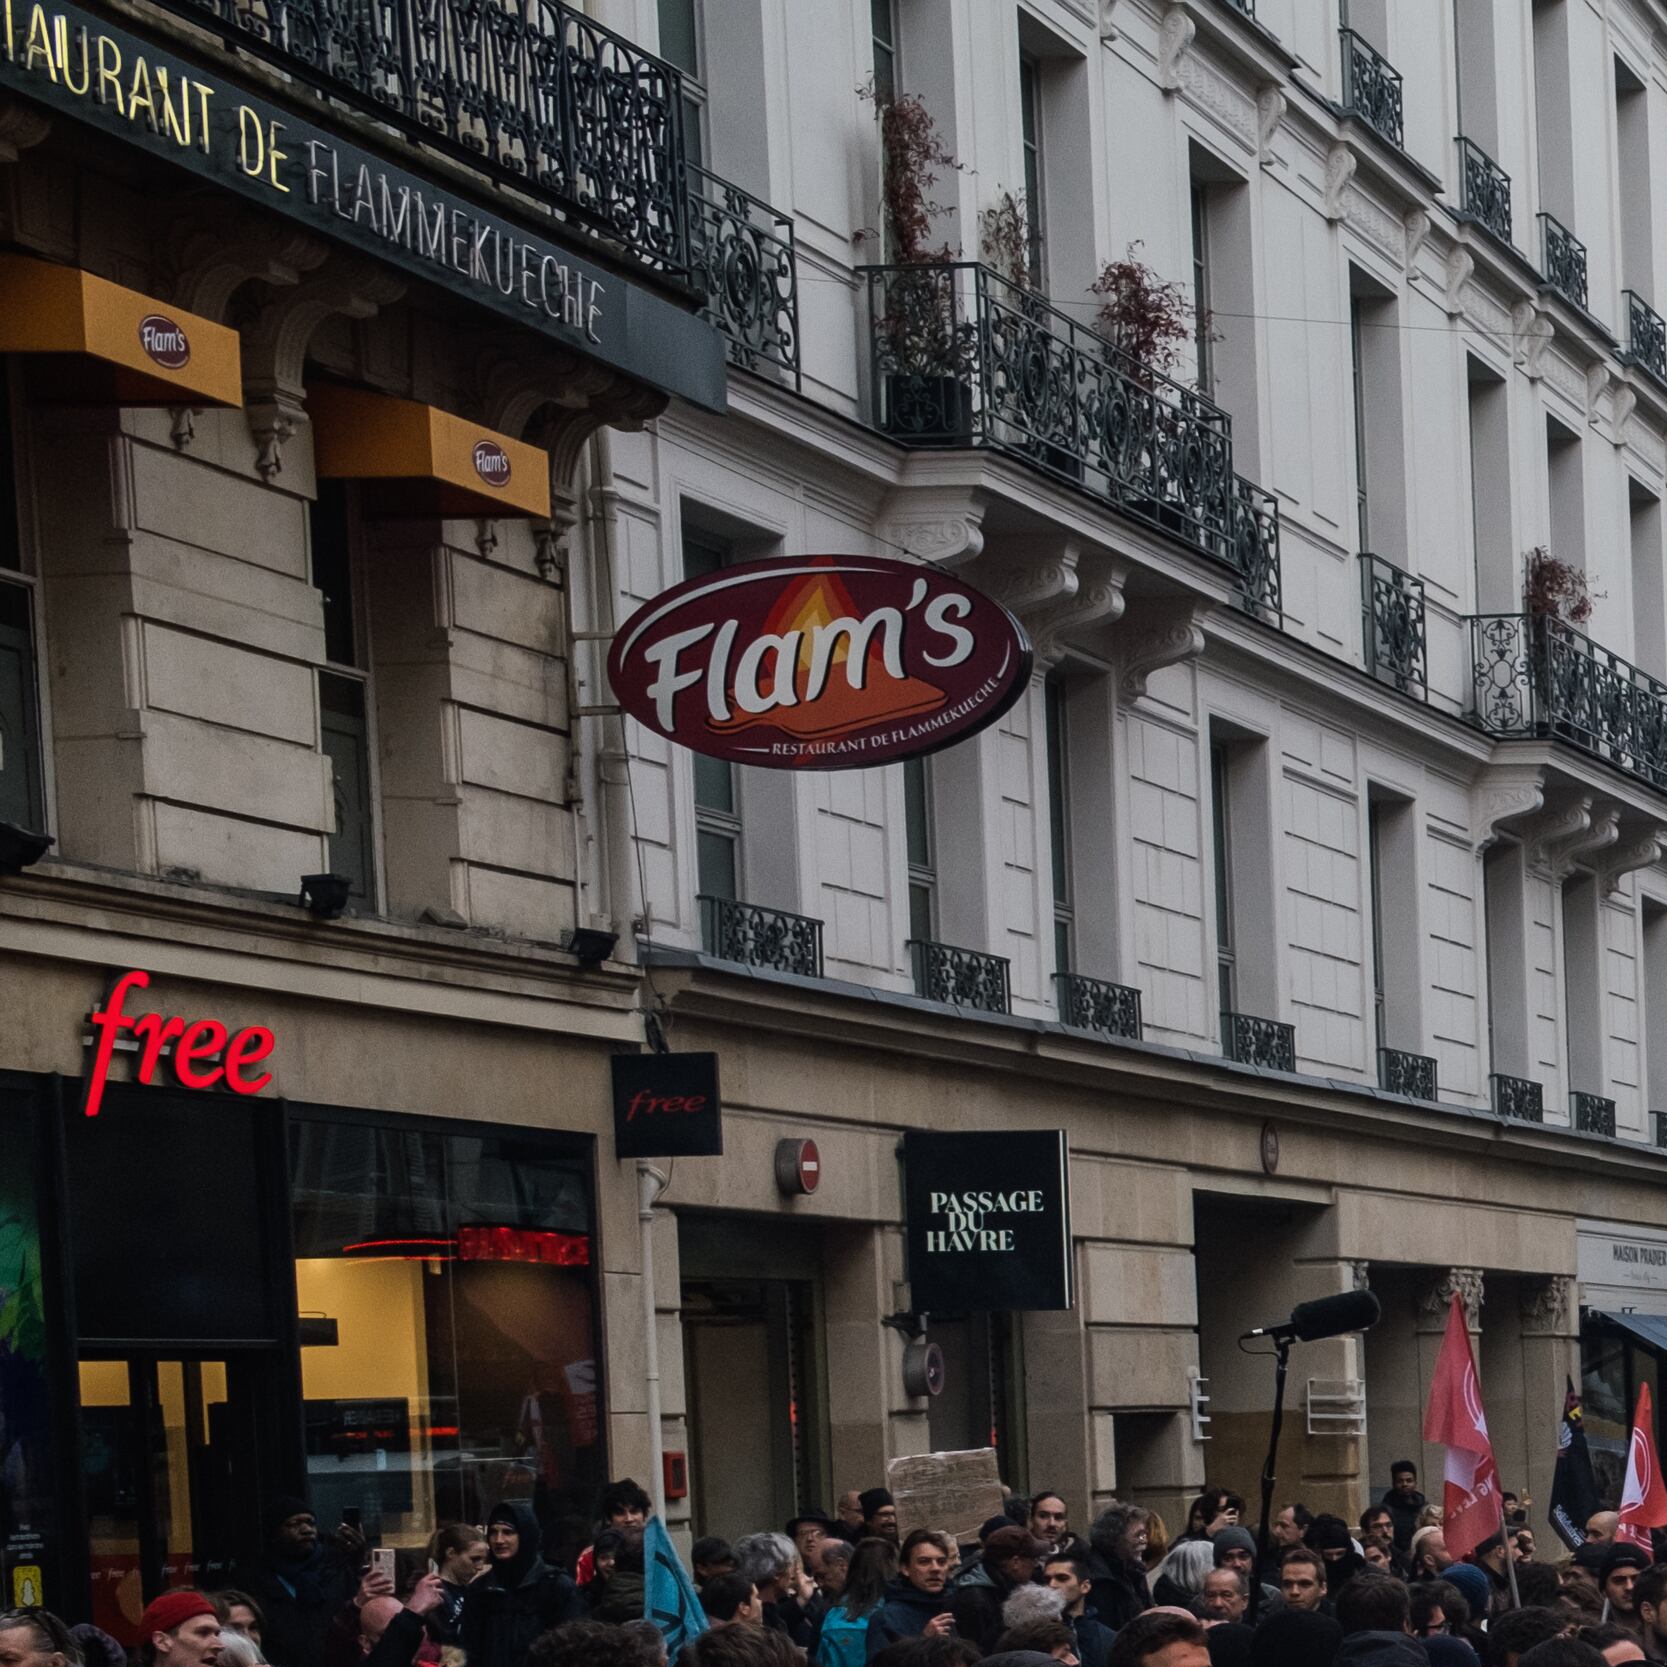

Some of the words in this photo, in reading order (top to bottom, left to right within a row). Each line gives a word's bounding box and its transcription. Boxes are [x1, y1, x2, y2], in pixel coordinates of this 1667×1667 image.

[239, 105, 290, 192] DE
[306, 139, 605, 343] FLAMMEKUECHE
[143, 327, 186, 353] Flam's
[475, 450, 510, 475] Flam's
[644, 578, 976, 732] Flam's
[772, 737, 868, 756] RESTAURANT
[871, 735, 889, 748] DE
[892, 677, 1000, 743] FLAMMEKUECHE
[84, 970, 275, 1117] free
[627, 1089, 707, 1123] free
[930, 1190, 1044, 1214] PASSAGE
[948, 1212, 985, 1233] DU
[926, 1229, 1015, 1253] HAVRE
[1612, 1244, 1638, 1263] MAISON
[1640, 1250, 1667, 1267] PRADIER
